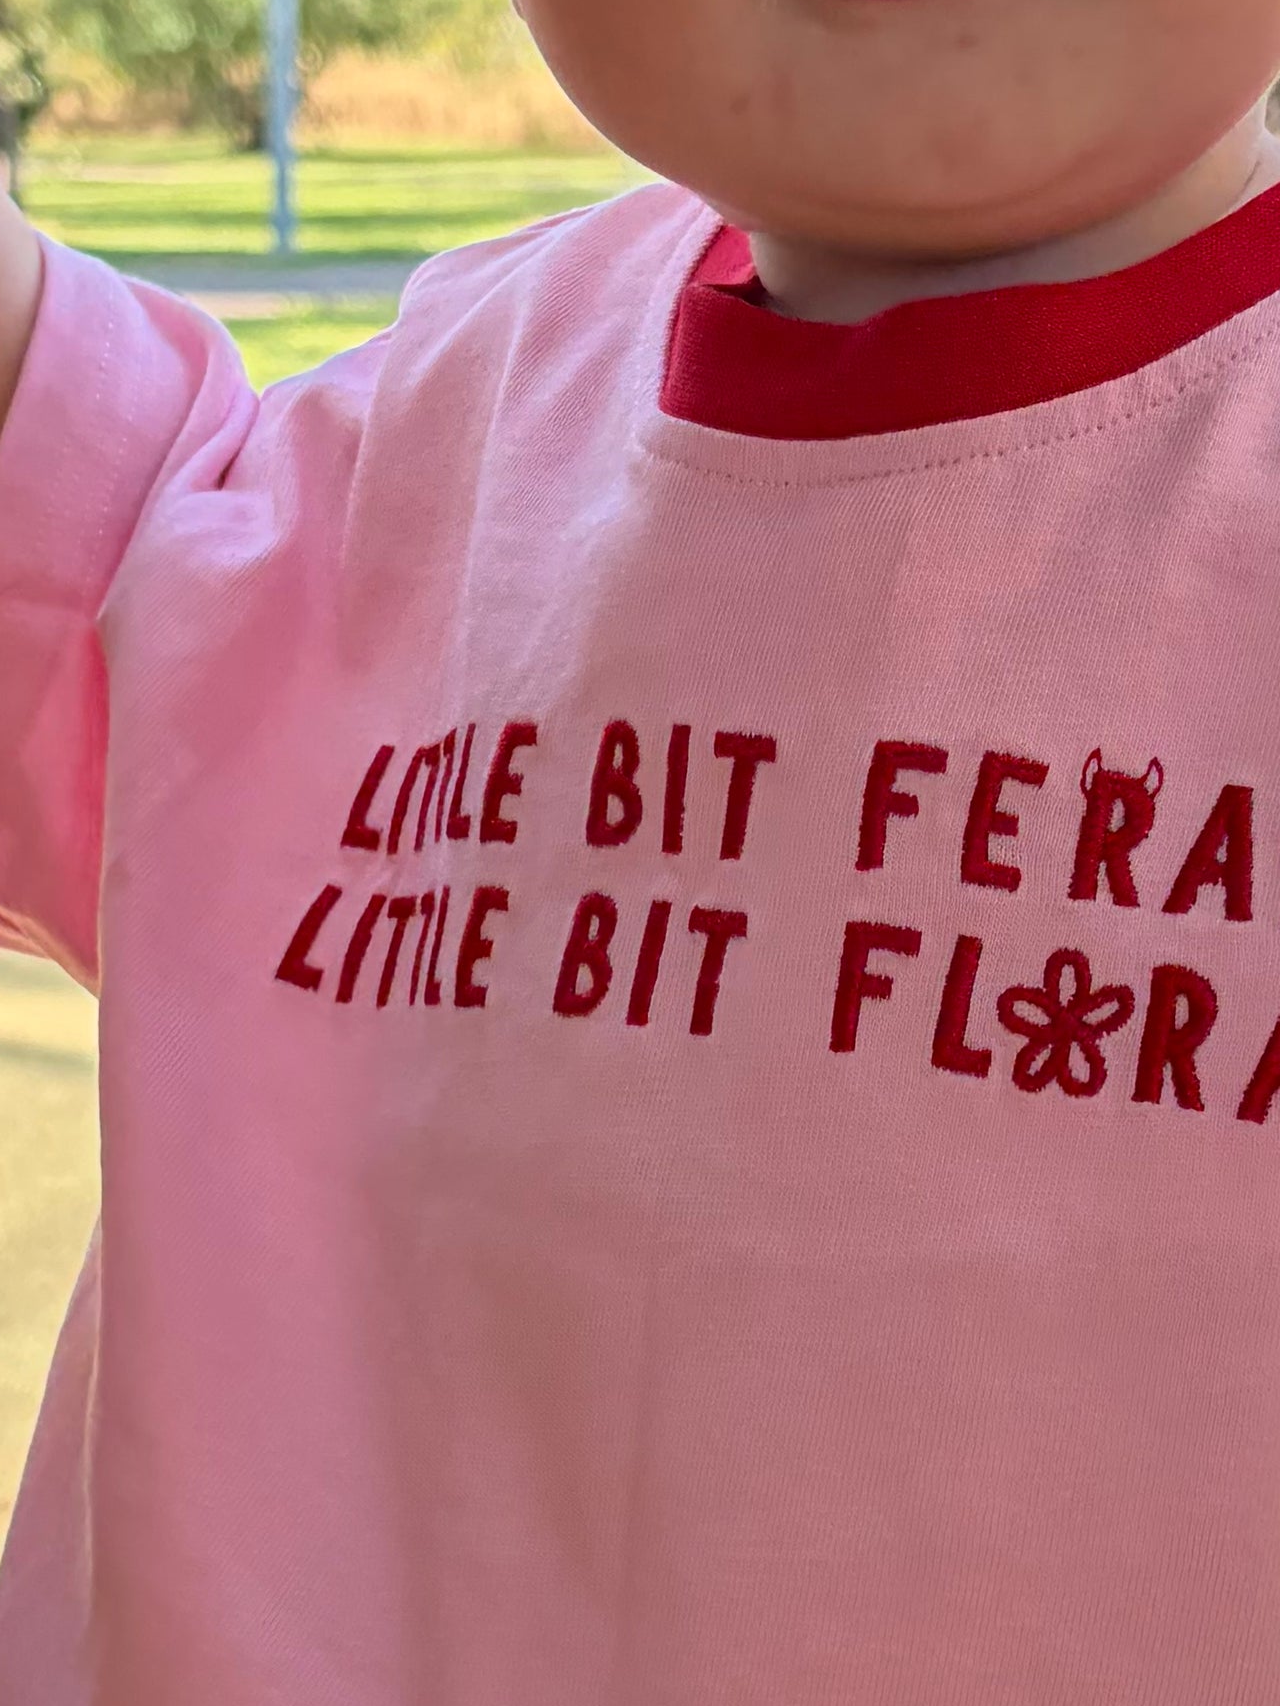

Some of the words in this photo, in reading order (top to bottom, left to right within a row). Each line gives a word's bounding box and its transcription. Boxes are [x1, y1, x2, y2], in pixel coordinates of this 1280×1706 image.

[339, 720, 539, 857] LITTLE
[584, 717, 779, 862] BIT
[273, 882, 511, 1010] LITTLE
[550, 889, 750, 1038] BIT
